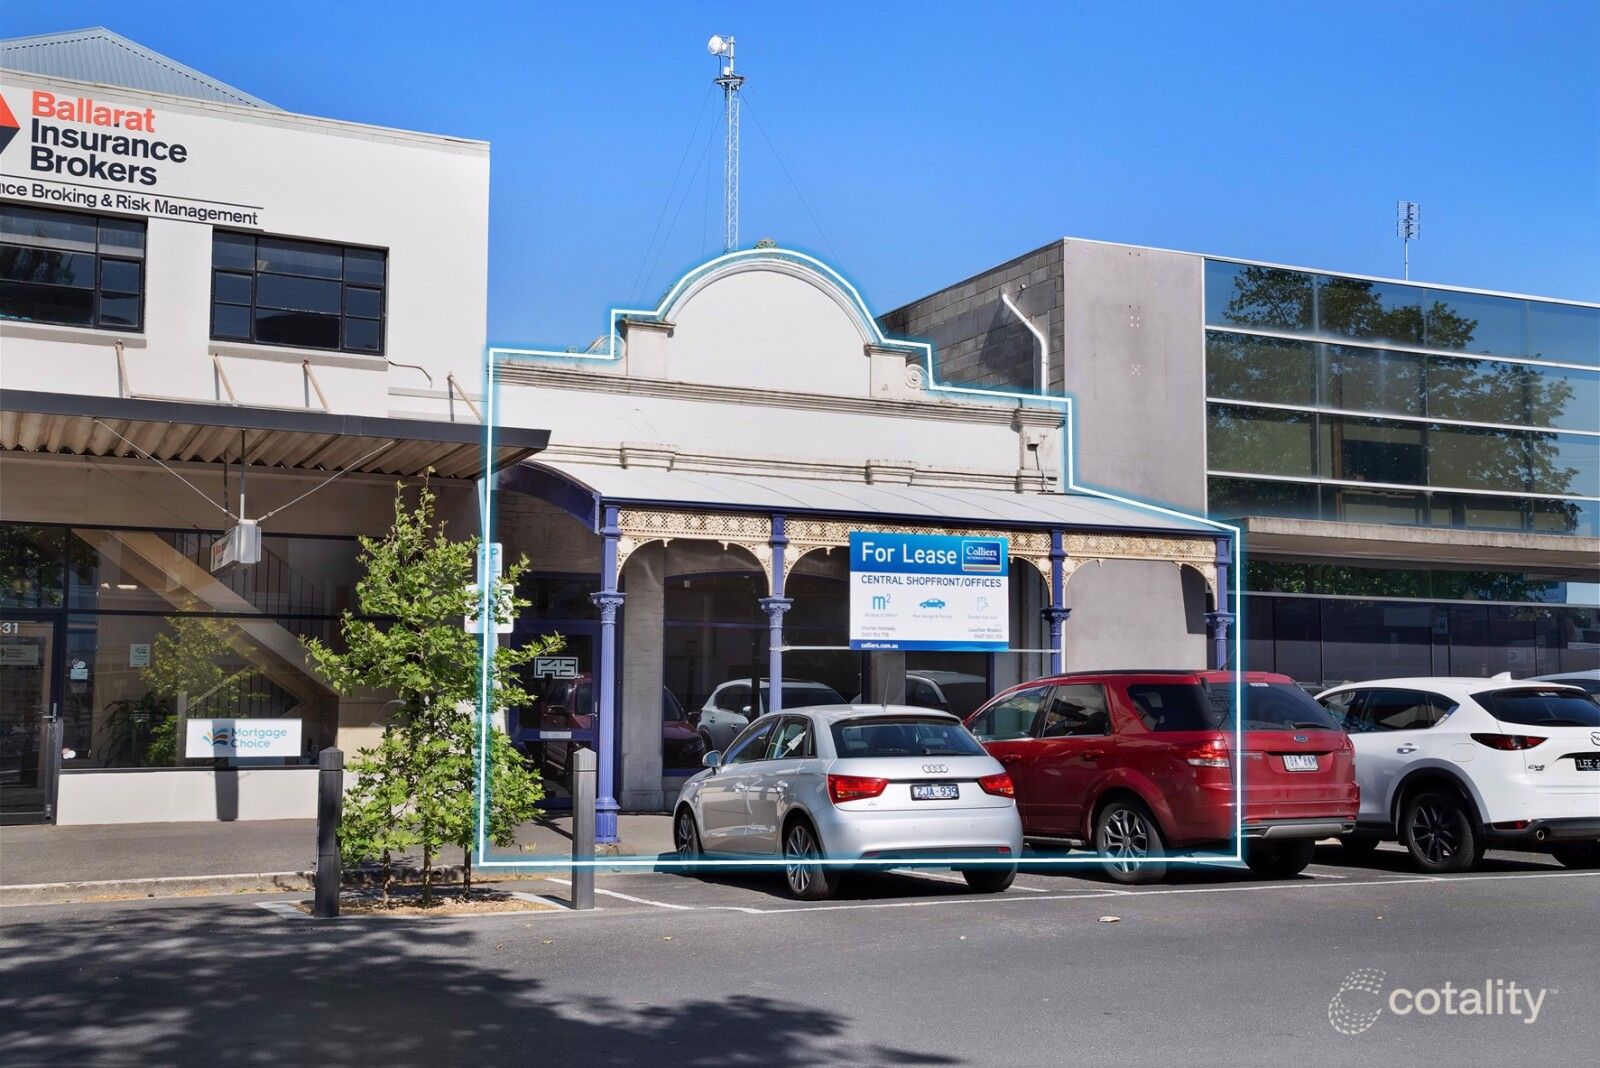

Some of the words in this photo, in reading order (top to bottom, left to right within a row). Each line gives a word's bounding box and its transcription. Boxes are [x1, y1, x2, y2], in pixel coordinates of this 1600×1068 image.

[32, 90, 156, 133] Ballarat
[31, 117, 188, 163] Insurance
[30, 145, 157, 186] Brokers
[32, 184, 97, 208] Broking
[101, 193, 112, 207] &
[116, 195, 150, 212] Risk
[154, 199, 258, 225] Management
[861, 541, 895, 562] For
[903, 543, 957, 564] Lease
[966, 545, 997, 557] Colliers
[861, 574, 903, 586] CENTRAL
[906, 576, 1001, 588] SHOPFRONT/OFFICES
[0, 622, 18, 634] 31
[536, 658, 577, 677] F45
[231, 728, 287, 739] Mortgage
[231, 739, 271, 748] Choice
